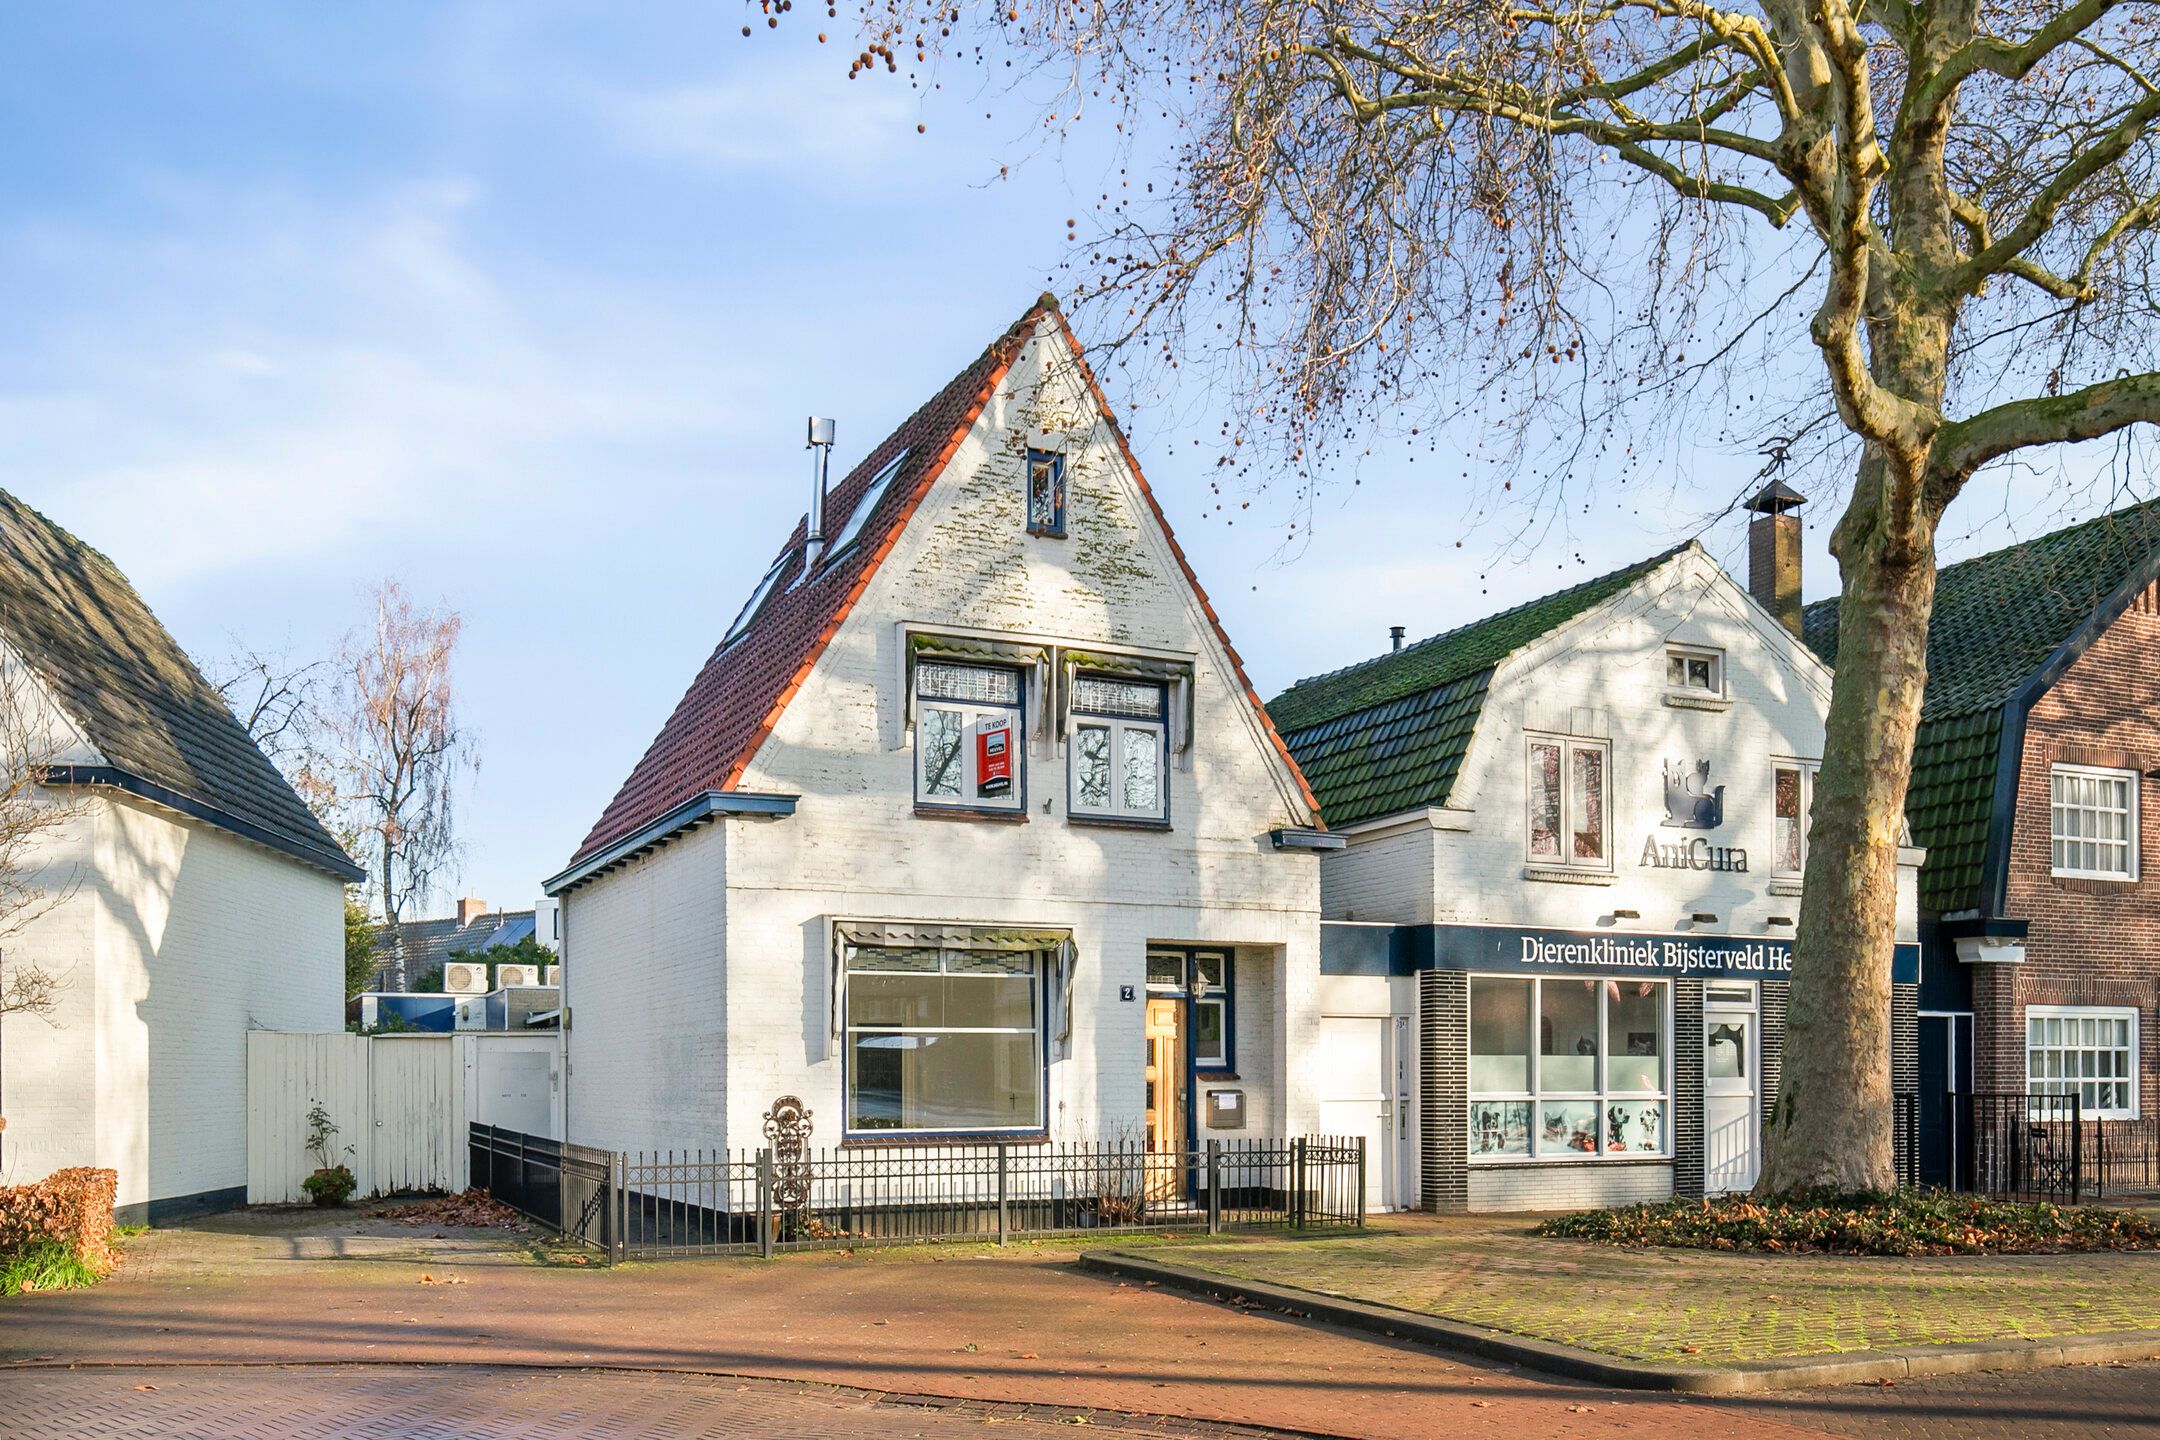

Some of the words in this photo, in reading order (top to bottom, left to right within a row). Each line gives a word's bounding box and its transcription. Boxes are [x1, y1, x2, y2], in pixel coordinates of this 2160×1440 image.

[985, 722, 991, 731] TE
[992, 718, 1007, 729] KOOP
[1638, 834, 1750, 873] AniCura
[1520, 936, 1660, 967] Dierenkliniek
[1662, 941, 1765, 974] Bijsterveld
[1125, 987, 1131, 999] 2
